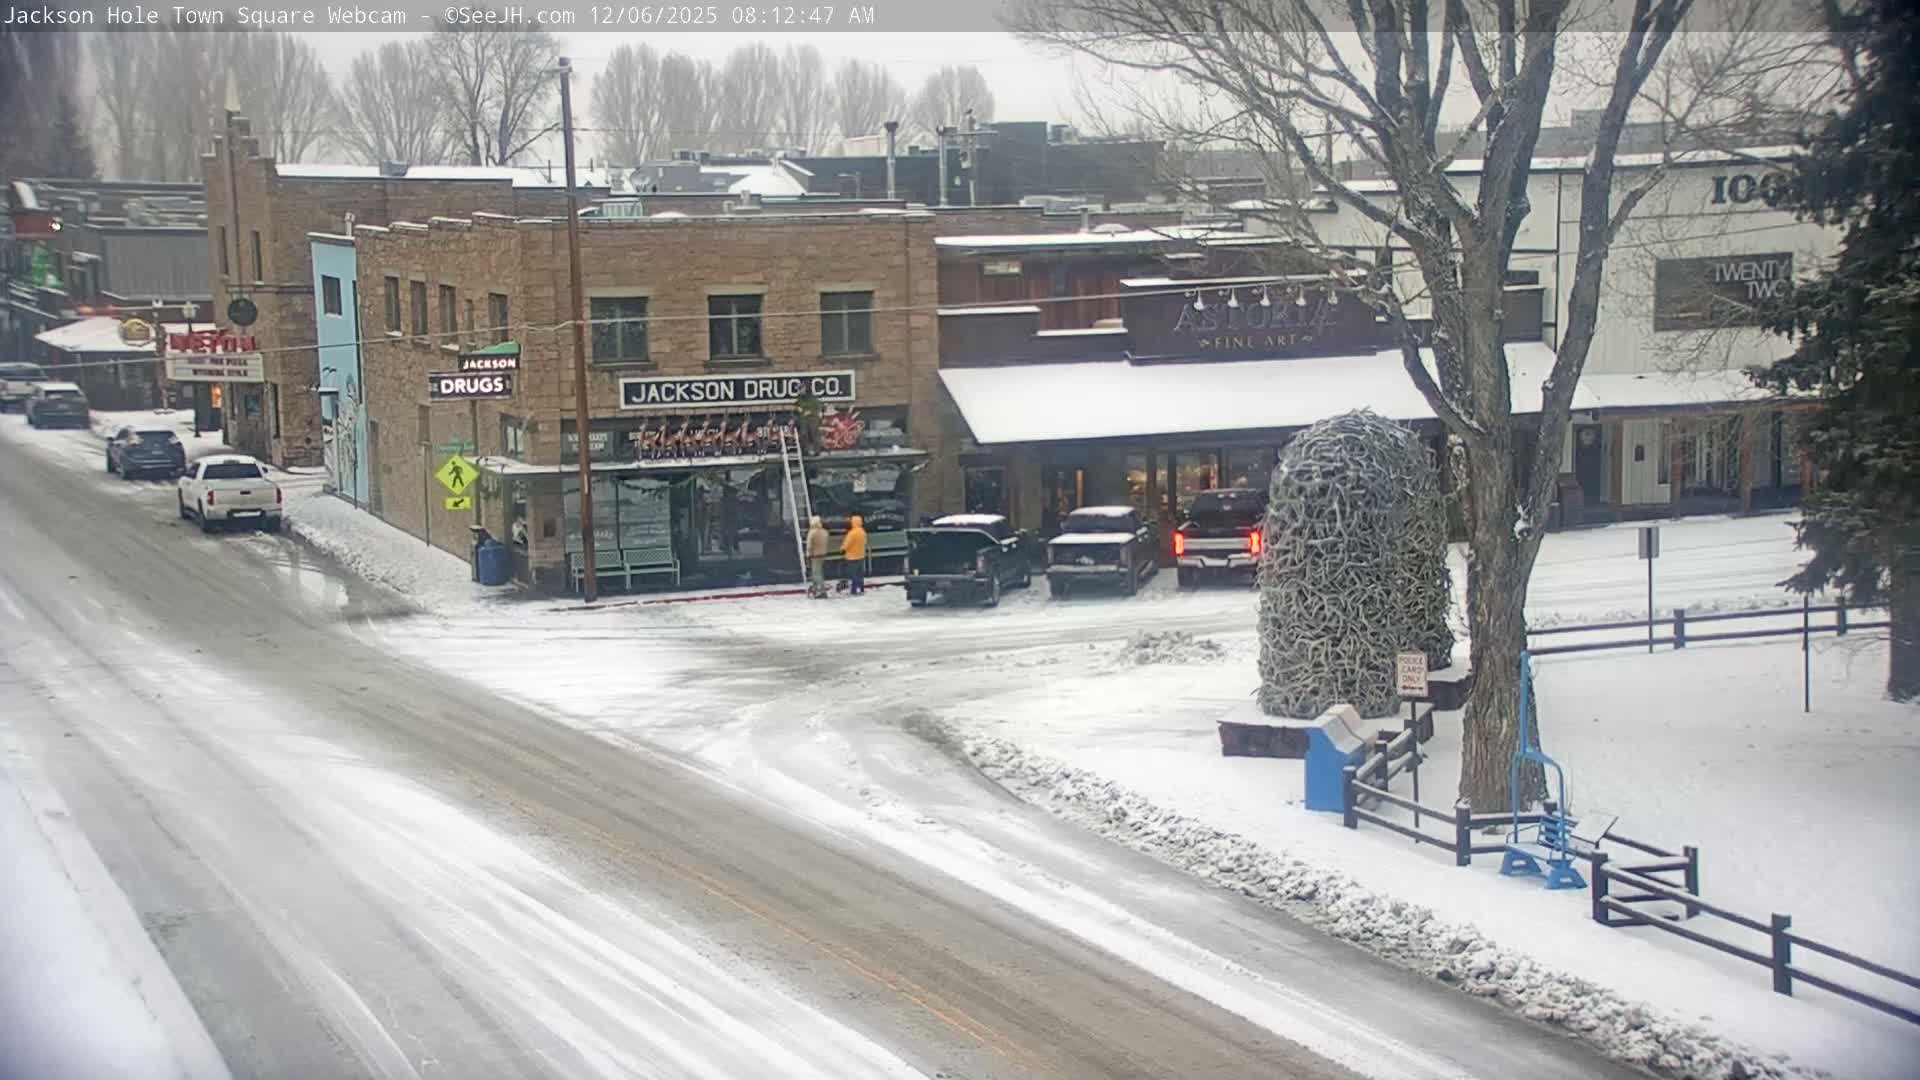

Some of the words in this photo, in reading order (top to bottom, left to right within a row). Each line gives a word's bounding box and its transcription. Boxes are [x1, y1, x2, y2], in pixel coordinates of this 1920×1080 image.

[1715, 260, 1790, 282] TWENTY
[1215, 335, 1254, 349] FINE
[1264, 332, 1297, 346] ART
[463, 359, 516, 369] JACKSON
[440, 377, 504, 394] DRUGS
[631, 380, 735, 403] JACKSON
[744, 378, 806, 400] DRUG
[811, 376, 844, 396] CO.
